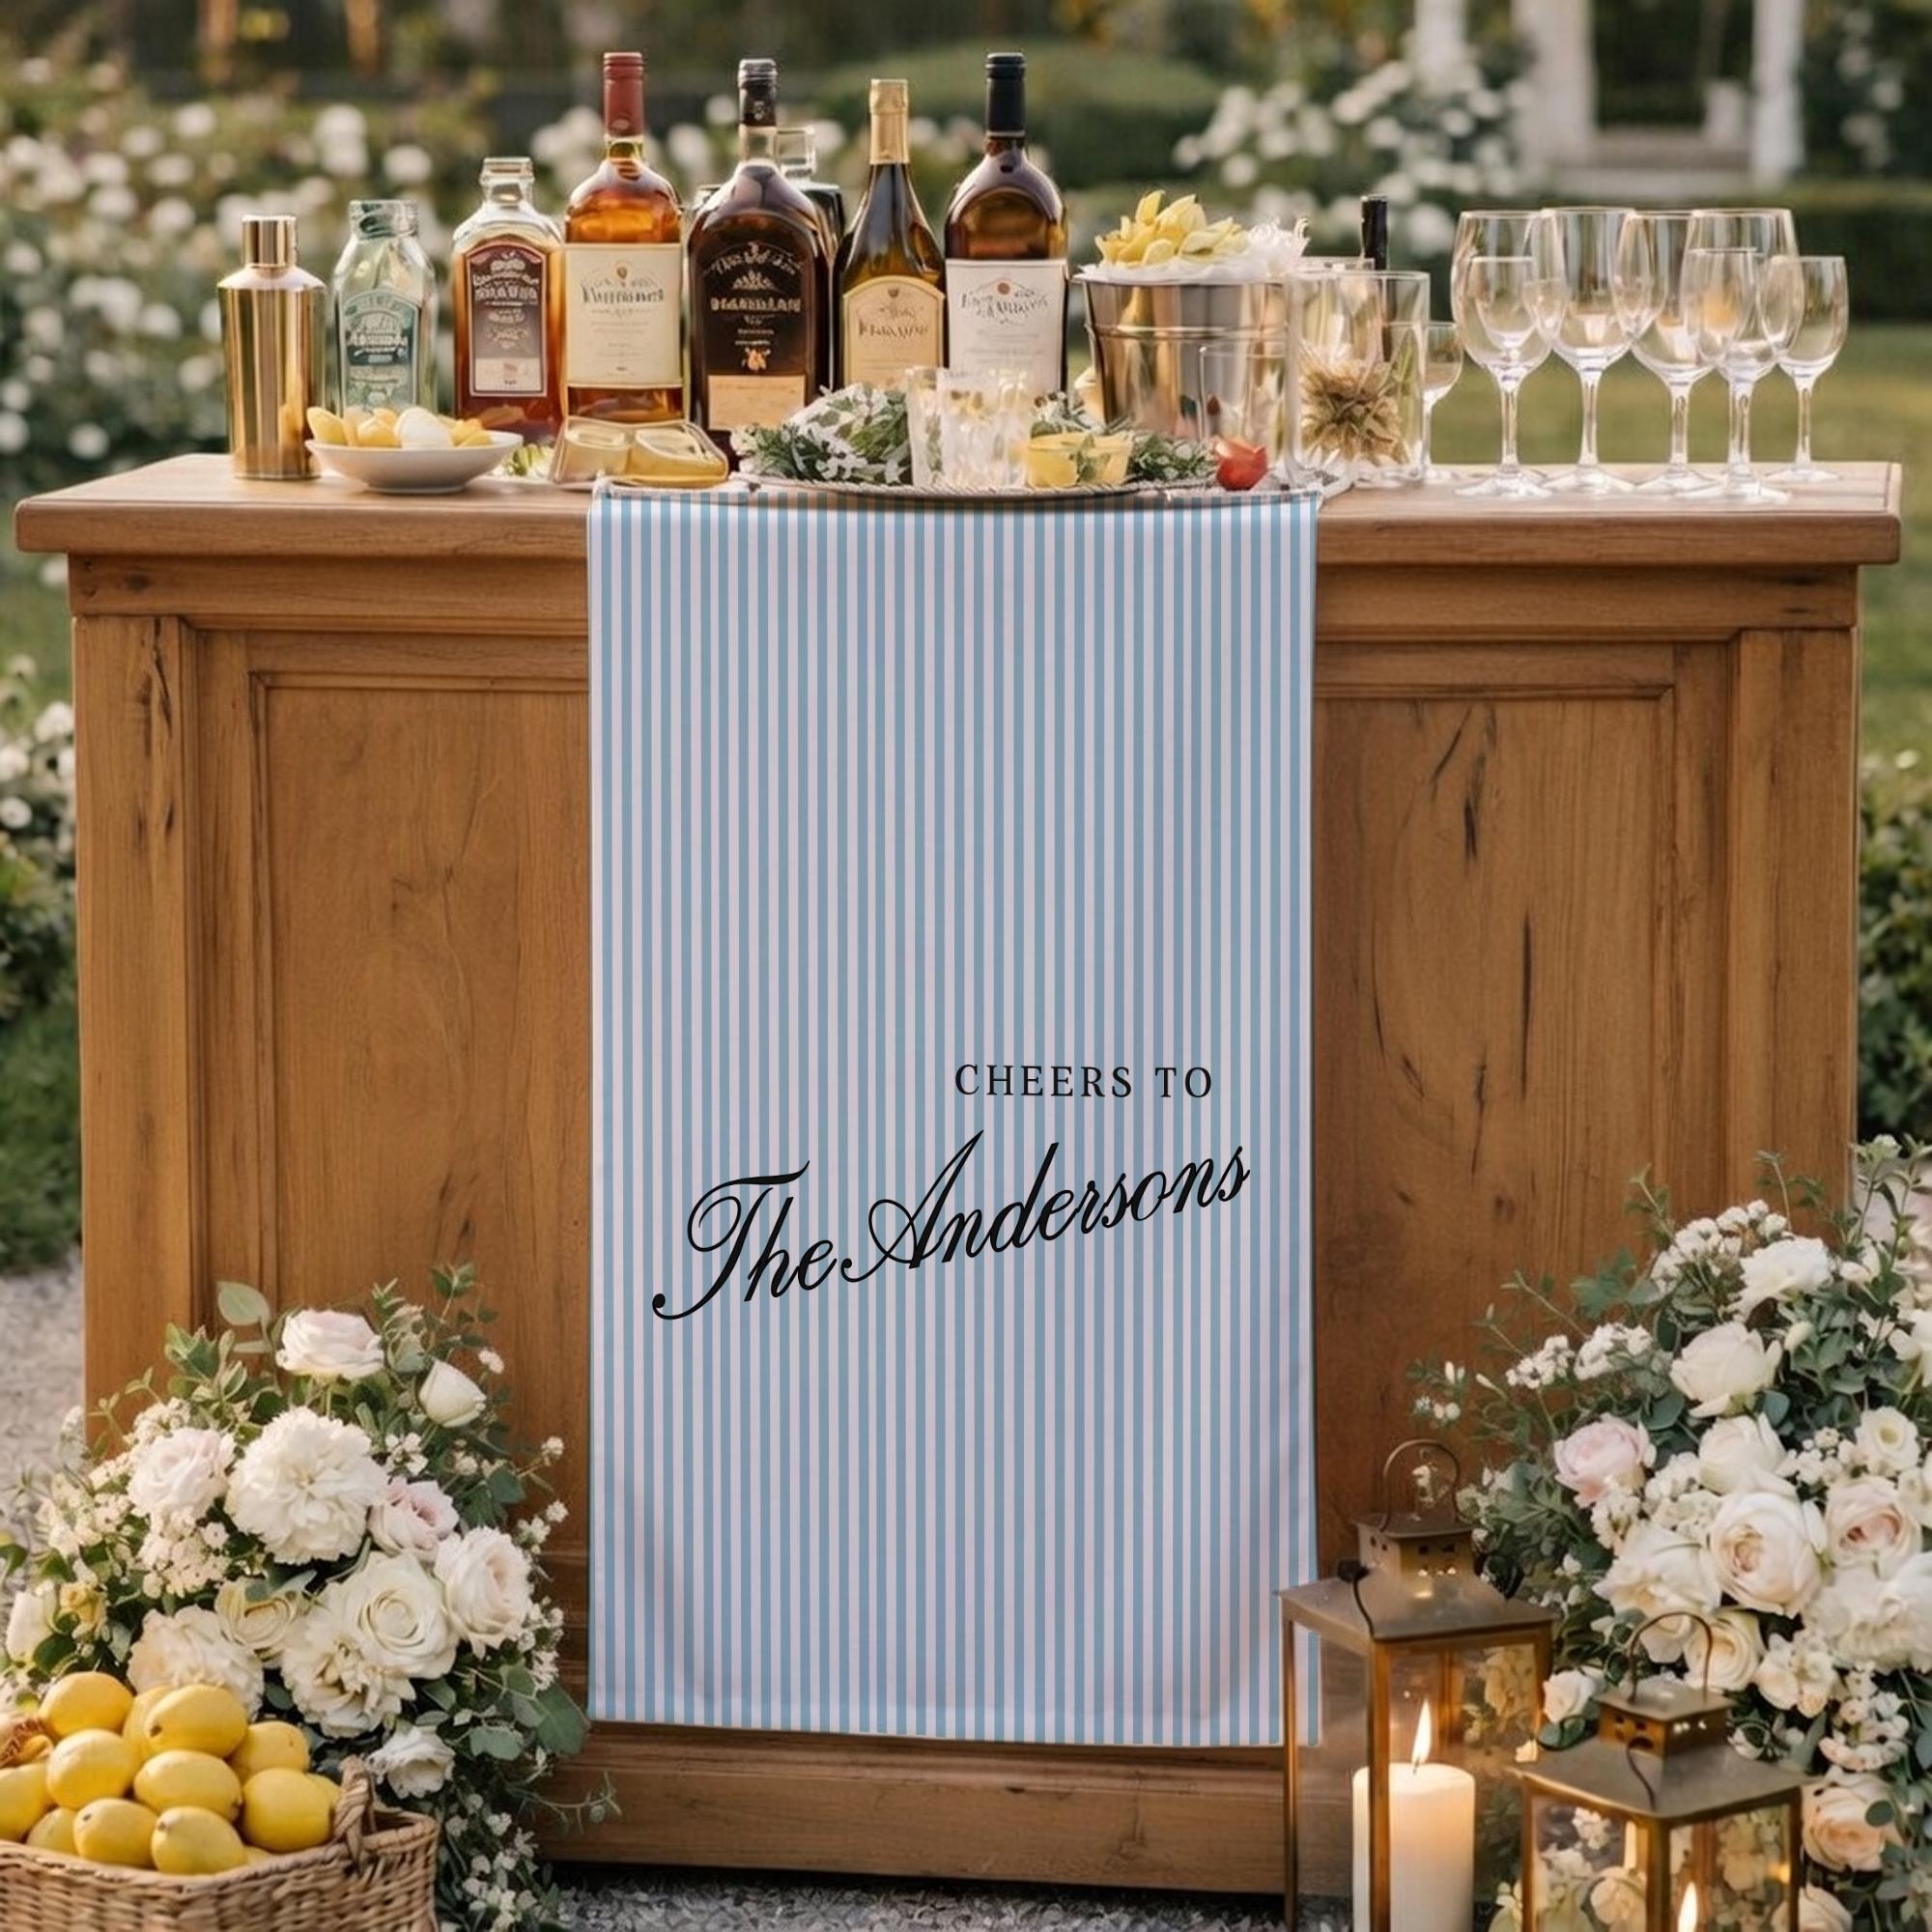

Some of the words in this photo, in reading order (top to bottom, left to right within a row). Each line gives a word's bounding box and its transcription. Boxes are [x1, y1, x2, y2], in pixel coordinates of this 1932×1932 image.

[955, 1064, 1132, 1098] CHEERS
[1154, 1066, 1213, 1098] TO
[652, 1160, 838, 1321] The
[839, 1129, 1251, 1283] Andersons
